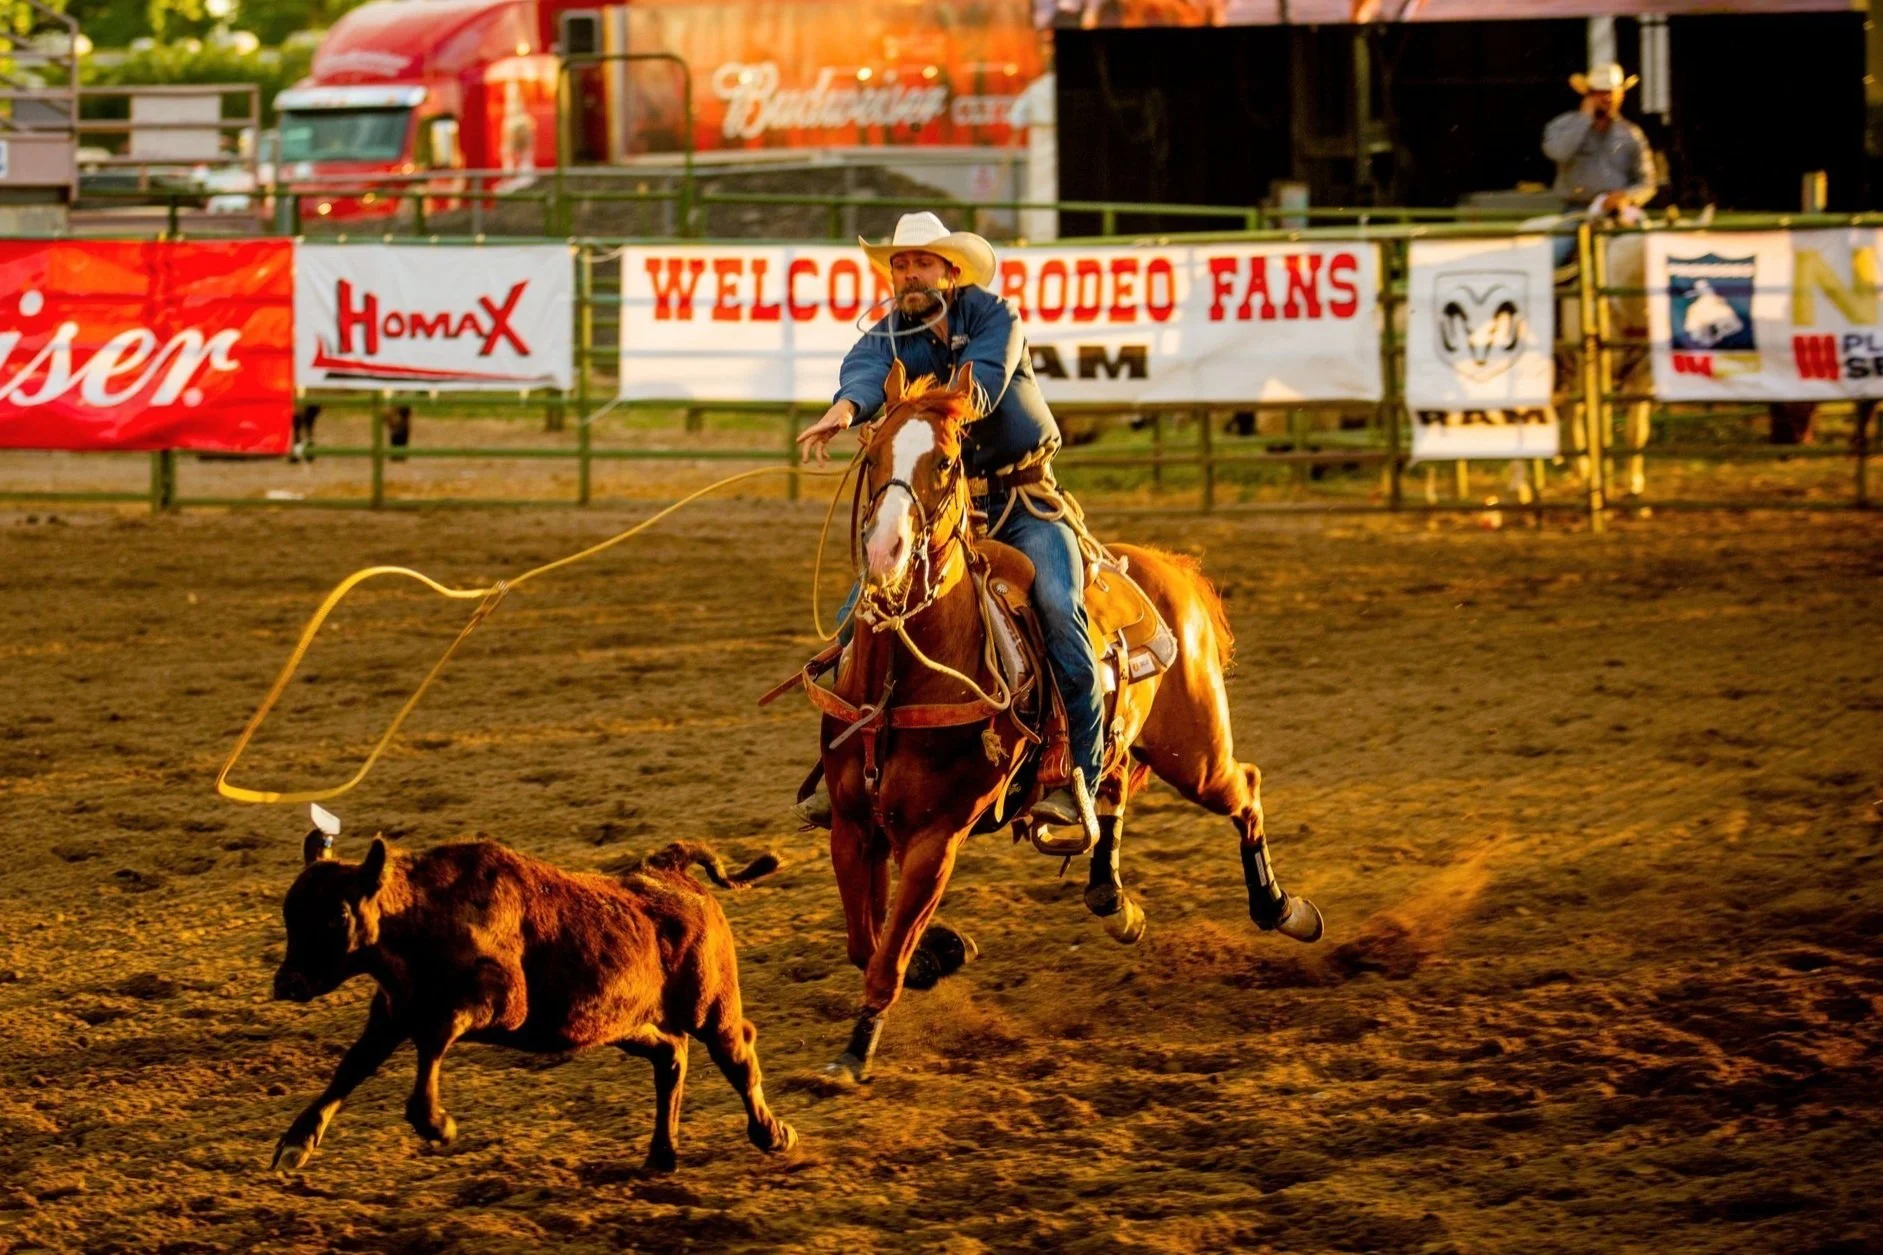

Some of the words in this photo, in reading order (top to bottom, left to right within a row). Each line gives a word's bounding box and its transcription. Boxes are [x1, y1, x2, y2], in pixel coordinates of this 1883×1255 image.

[645, 257, 895, 323] WELCO
[1000, 257, 1177, 323] RODEO
[1208, 251, 1358, 320] FANS
[1028, 345, 1149, 379] AM
